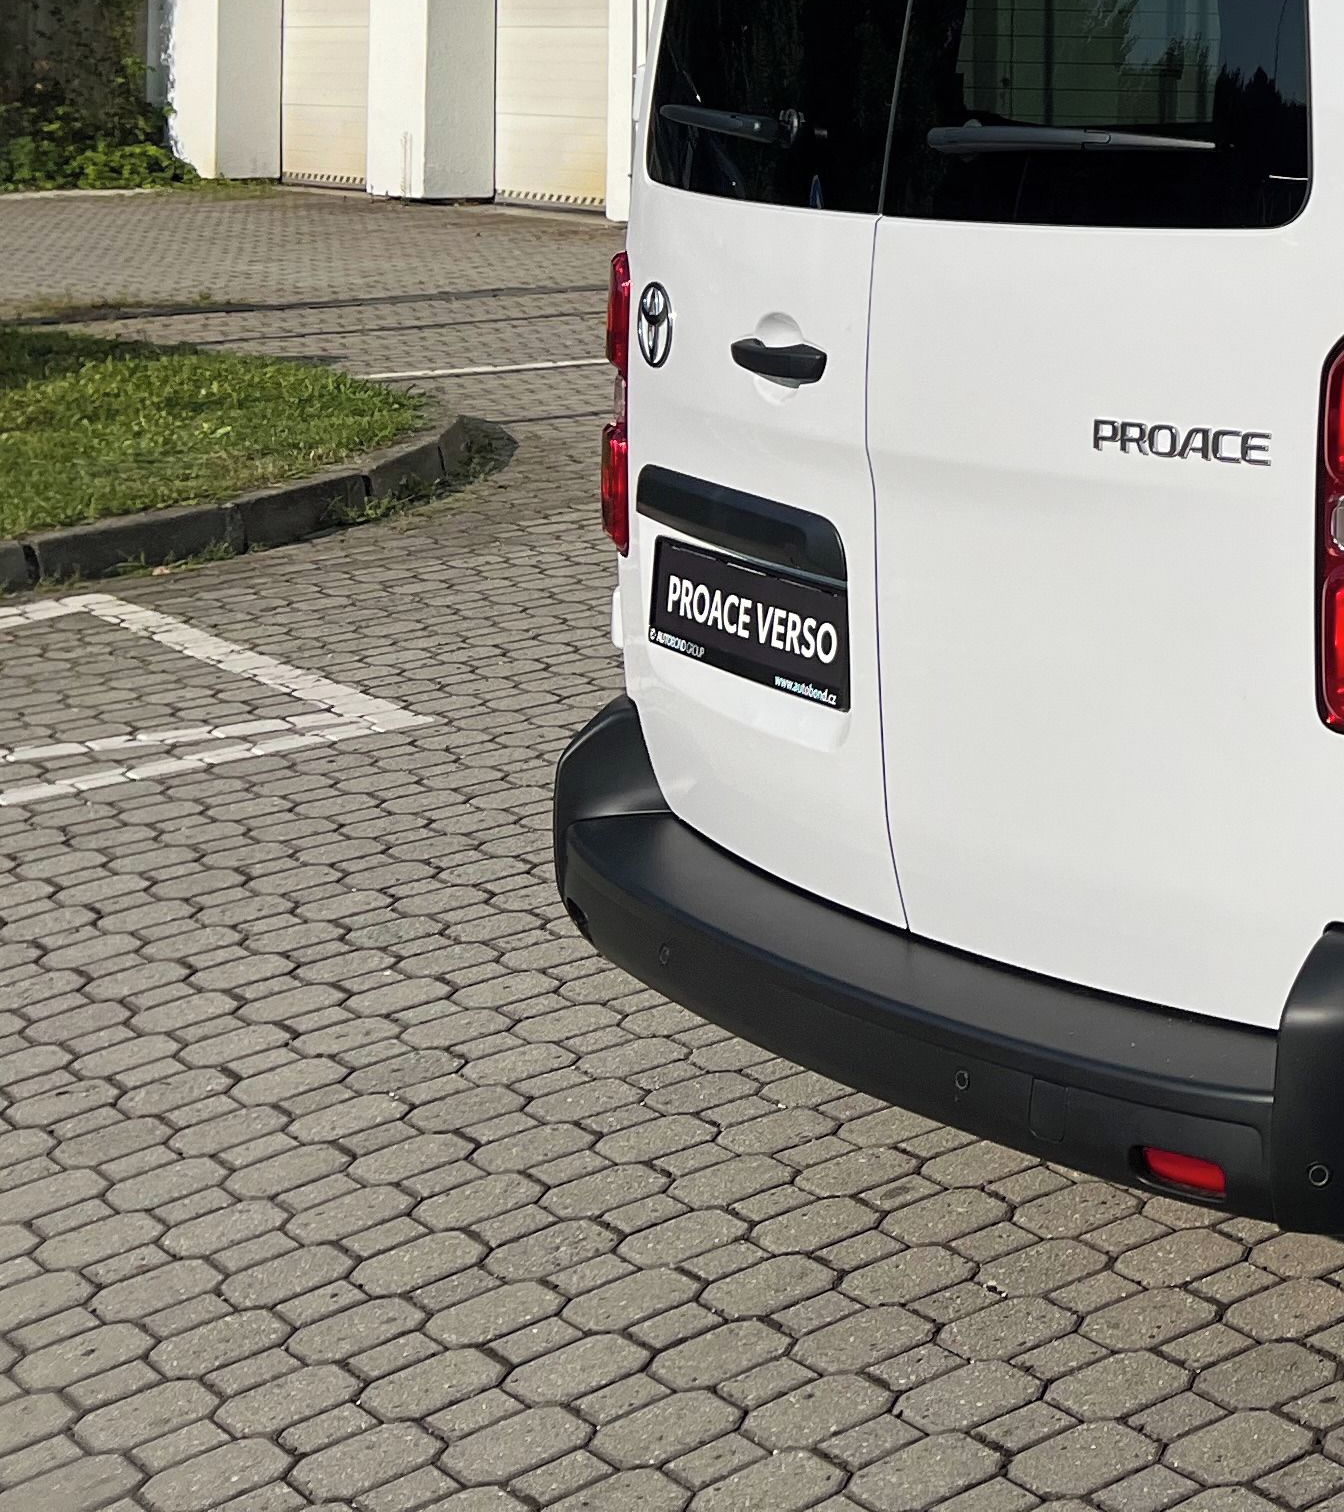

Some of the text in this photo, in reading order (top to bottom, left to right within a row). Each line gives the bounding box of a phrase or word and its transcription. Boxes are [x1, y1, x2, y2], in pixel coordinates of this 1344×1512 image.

[1092, 418, 1273, 467] PROACE
[667, 574, 838, 664] PROACE VERSO
[774, 675, 837, 706] www.autobond.cz
